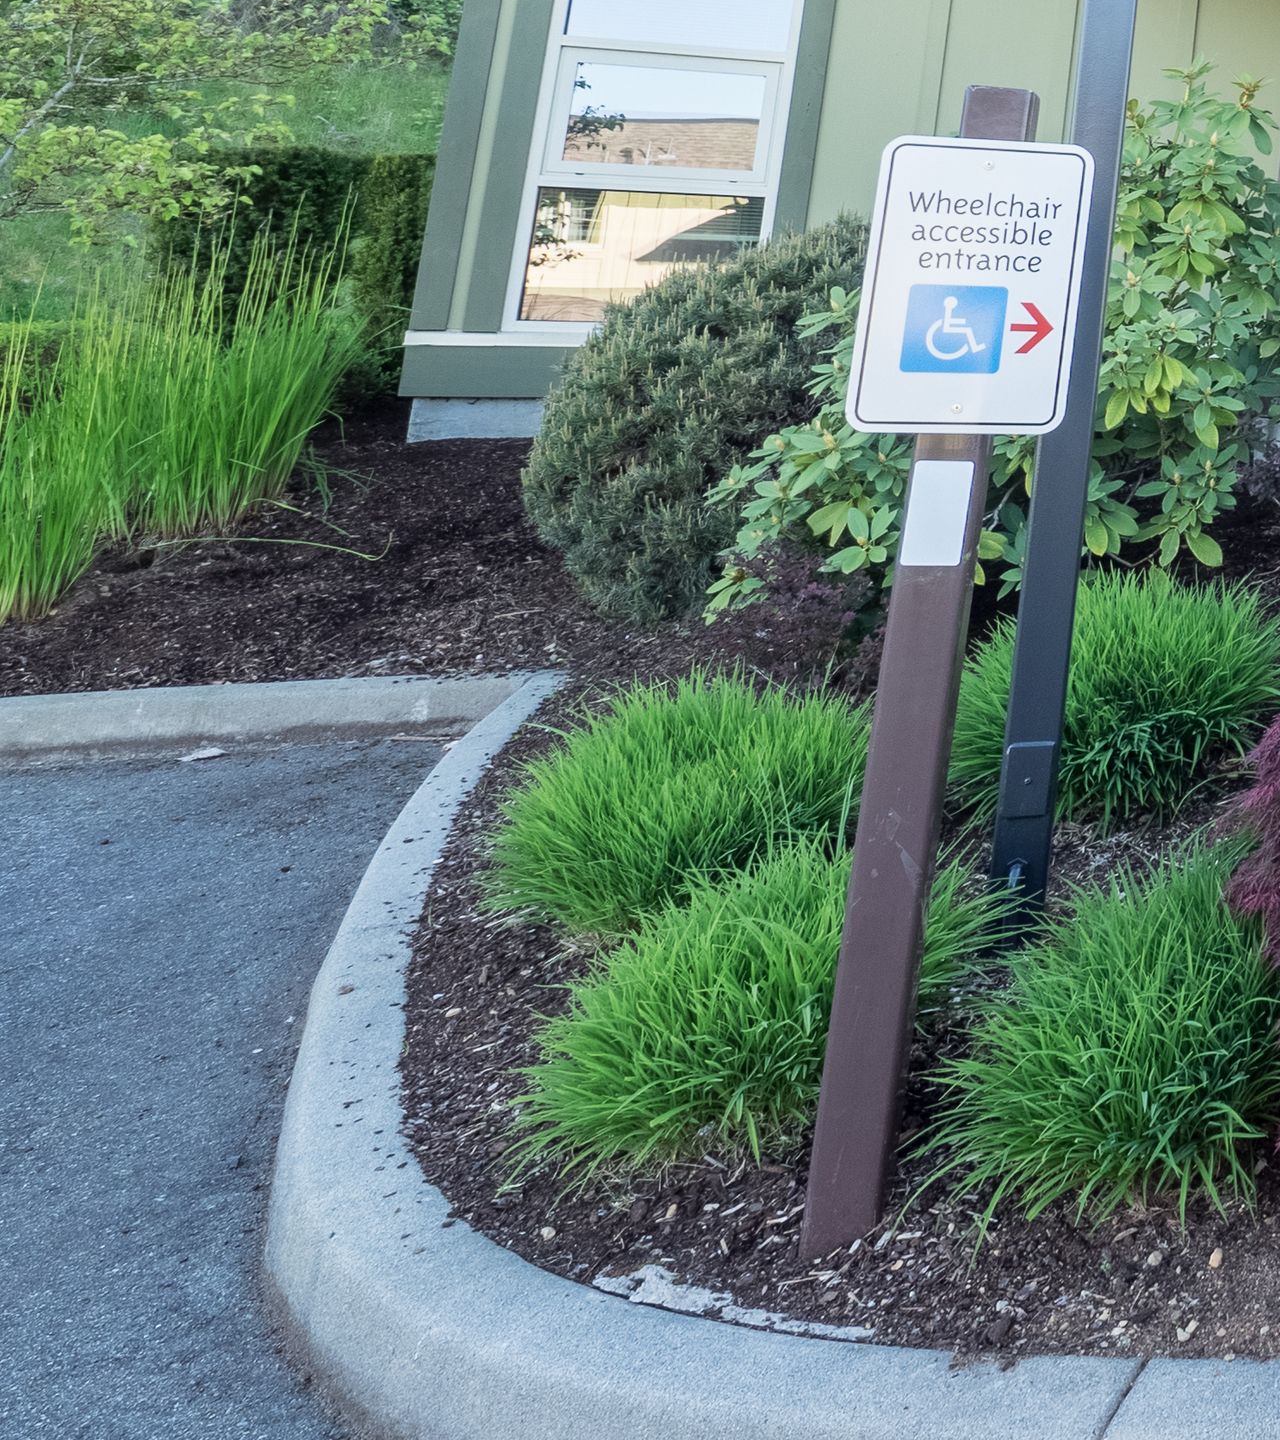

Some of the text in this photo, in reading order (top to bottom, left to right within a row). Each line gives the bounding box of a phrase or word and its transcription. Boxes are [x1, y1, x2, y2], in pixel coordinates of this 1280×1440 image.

[909, 190, 1063, 220] Wheelchair
[911, 221, 1053, 246] accessible
[918, 249, 1042, 273] entrance
